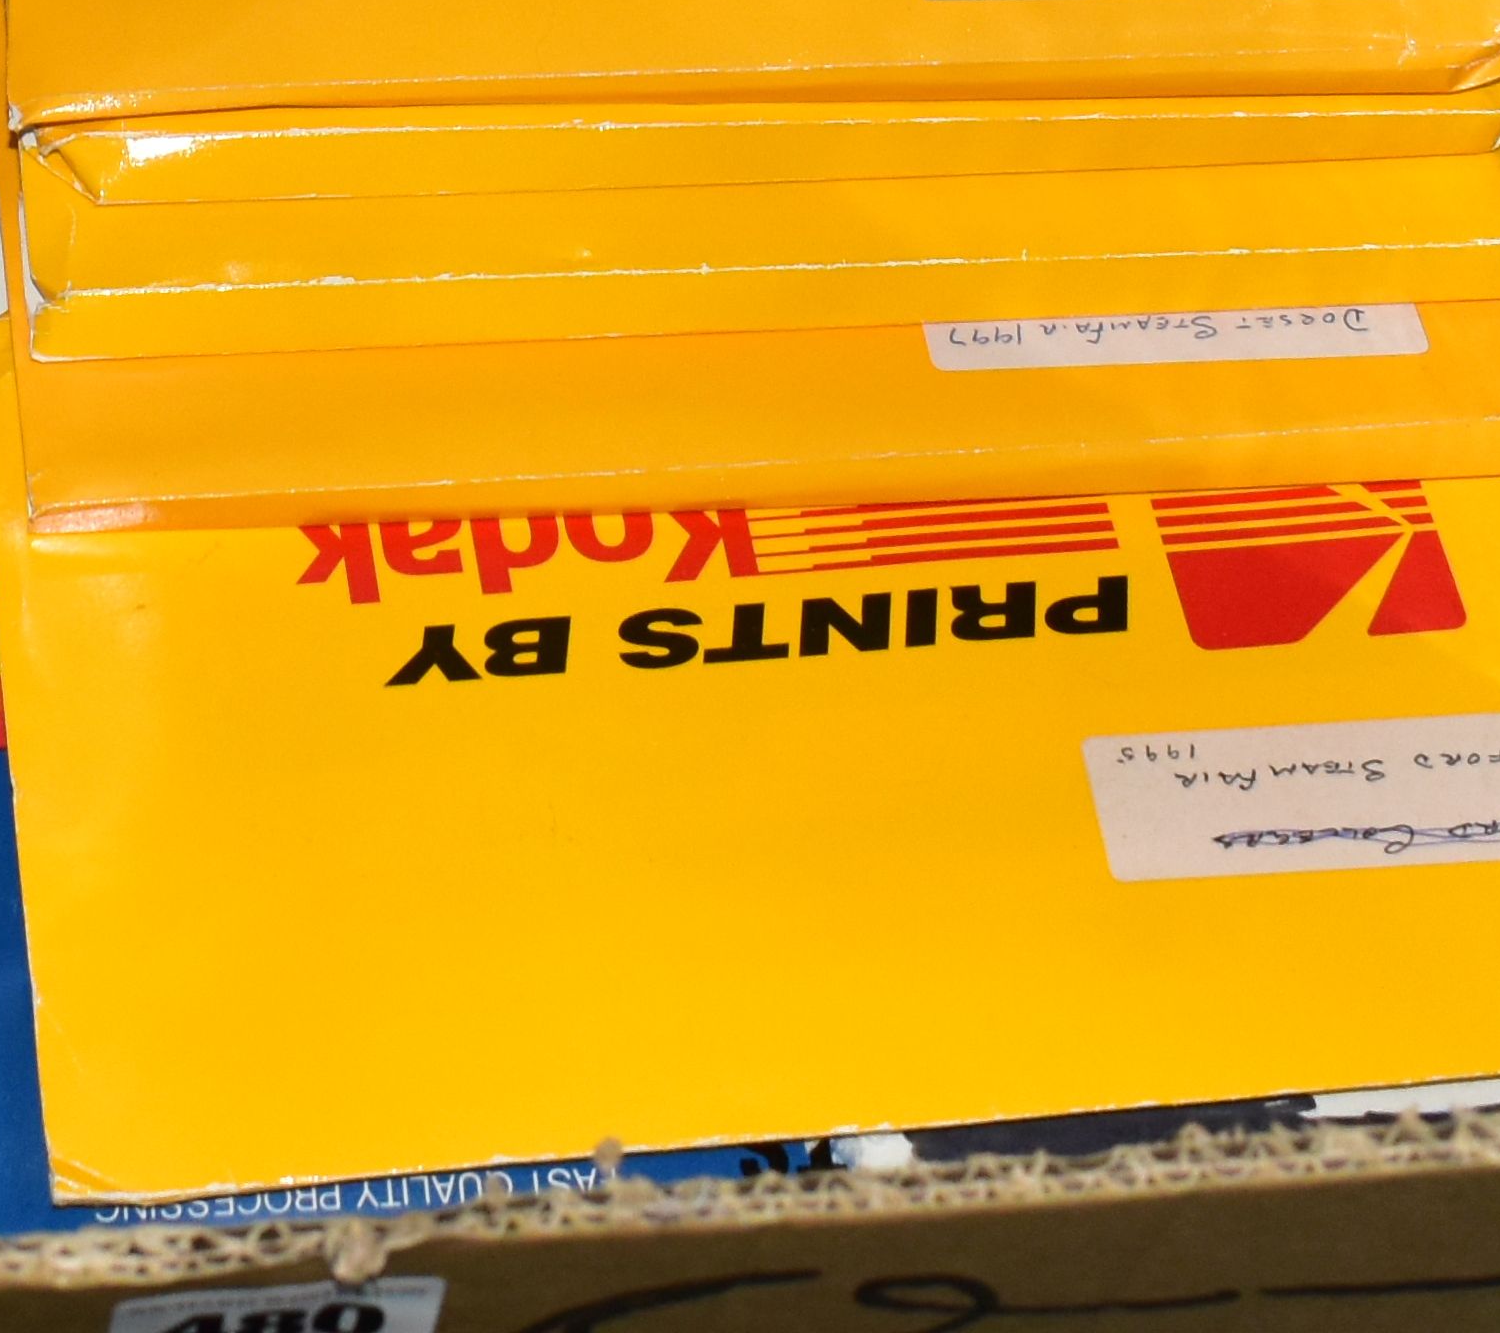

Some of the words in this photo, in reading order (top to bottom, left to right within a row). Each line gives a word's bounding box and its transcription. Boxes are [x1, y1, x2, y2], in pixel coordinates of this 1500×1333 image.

[1234, 308, 1367, 331] DORSET
[946, 323, 1022, 345] 1997
[296, 508, 757, 605] Kodak
[618, 576, 1130, 671] PRINTS
[383, 615, 571, 687] BY
[1117, 743, 1195, 764] 1995
[1173, 767, 1256, 789] FAIR
[1272, 758, 1385, 782] STEAM
